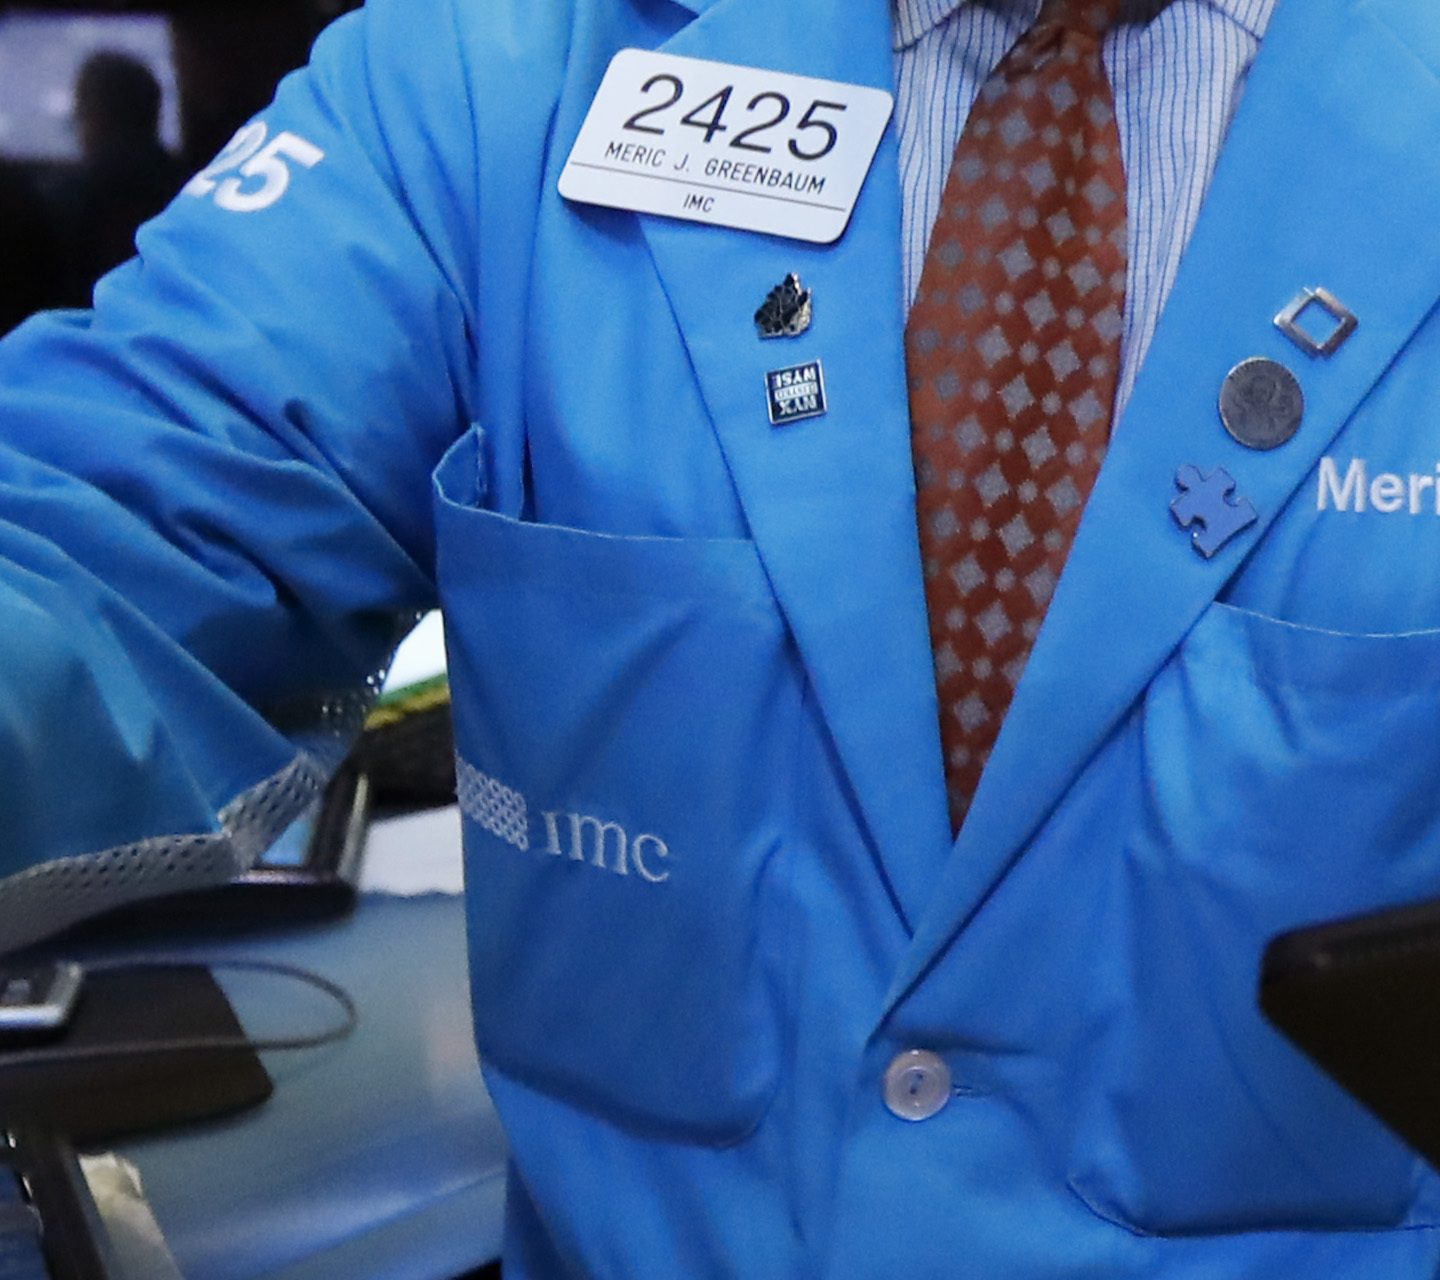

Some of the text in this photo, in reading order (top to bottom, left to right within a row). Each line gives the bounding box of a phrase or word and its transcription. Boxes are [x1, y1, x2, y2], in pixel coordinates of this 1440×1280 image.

[622, 73, 847, 161] 2425
[604, 140, 827, 195] MERIC J. GREENBAUM
[682, 193, 715, 212] IMC
[540, 811, 669, 883] imc
